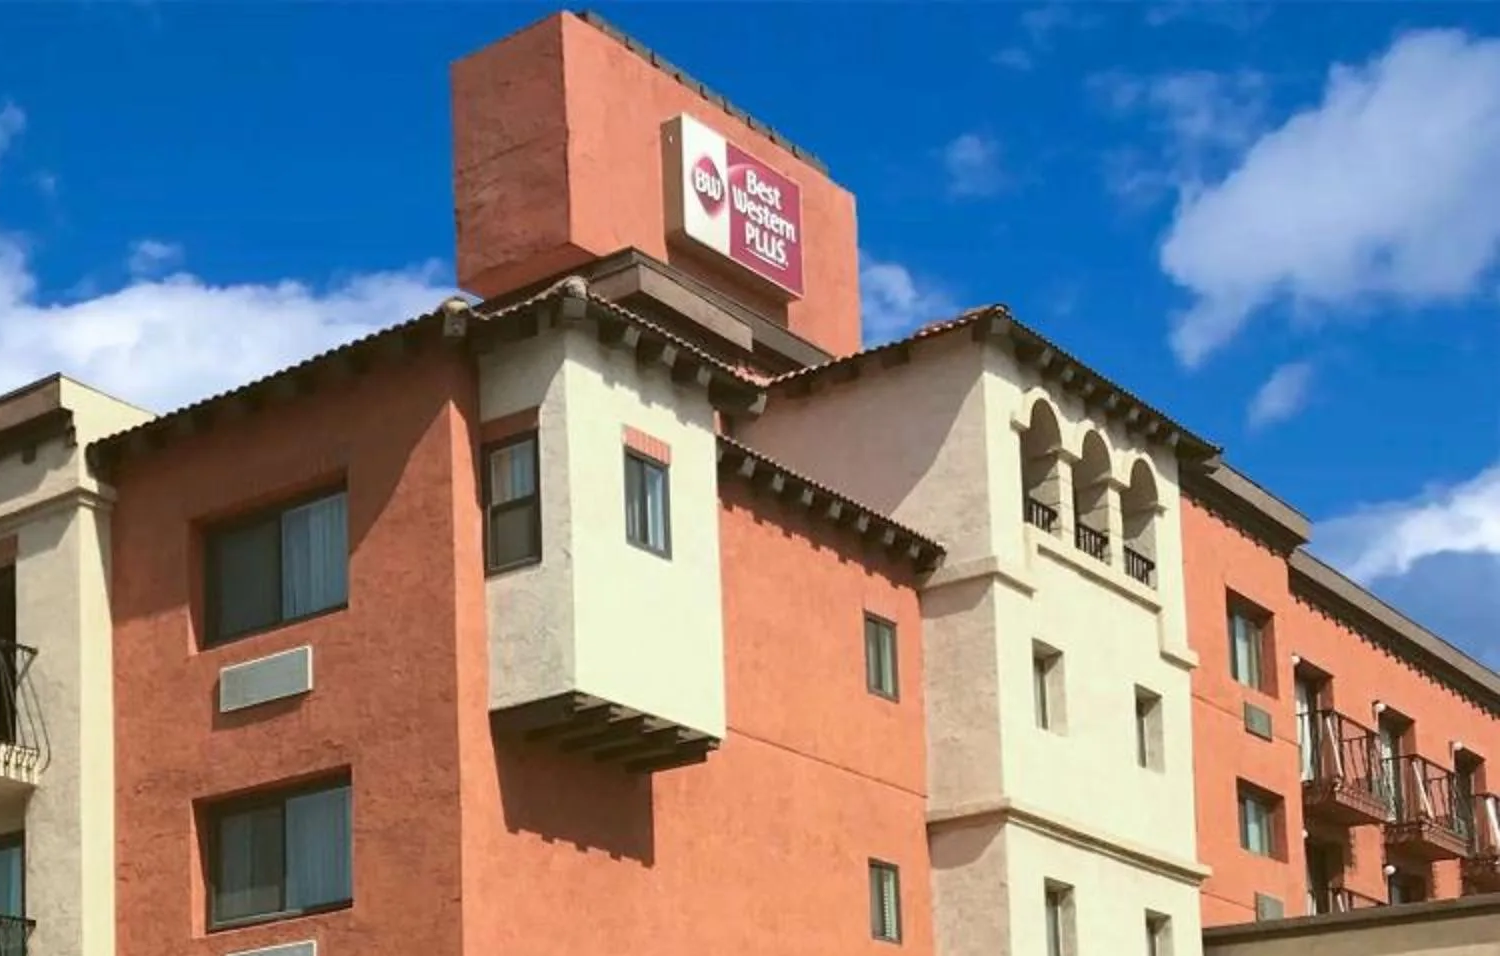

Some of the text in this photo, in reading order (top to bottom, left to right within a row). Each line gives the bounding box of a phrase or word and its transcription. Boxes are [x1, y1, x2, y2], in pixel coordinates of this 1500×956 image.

[694, 167, 721, 201] BW
[746, 170, 782, 210] Best
[732, 185, 796, 243] Western
